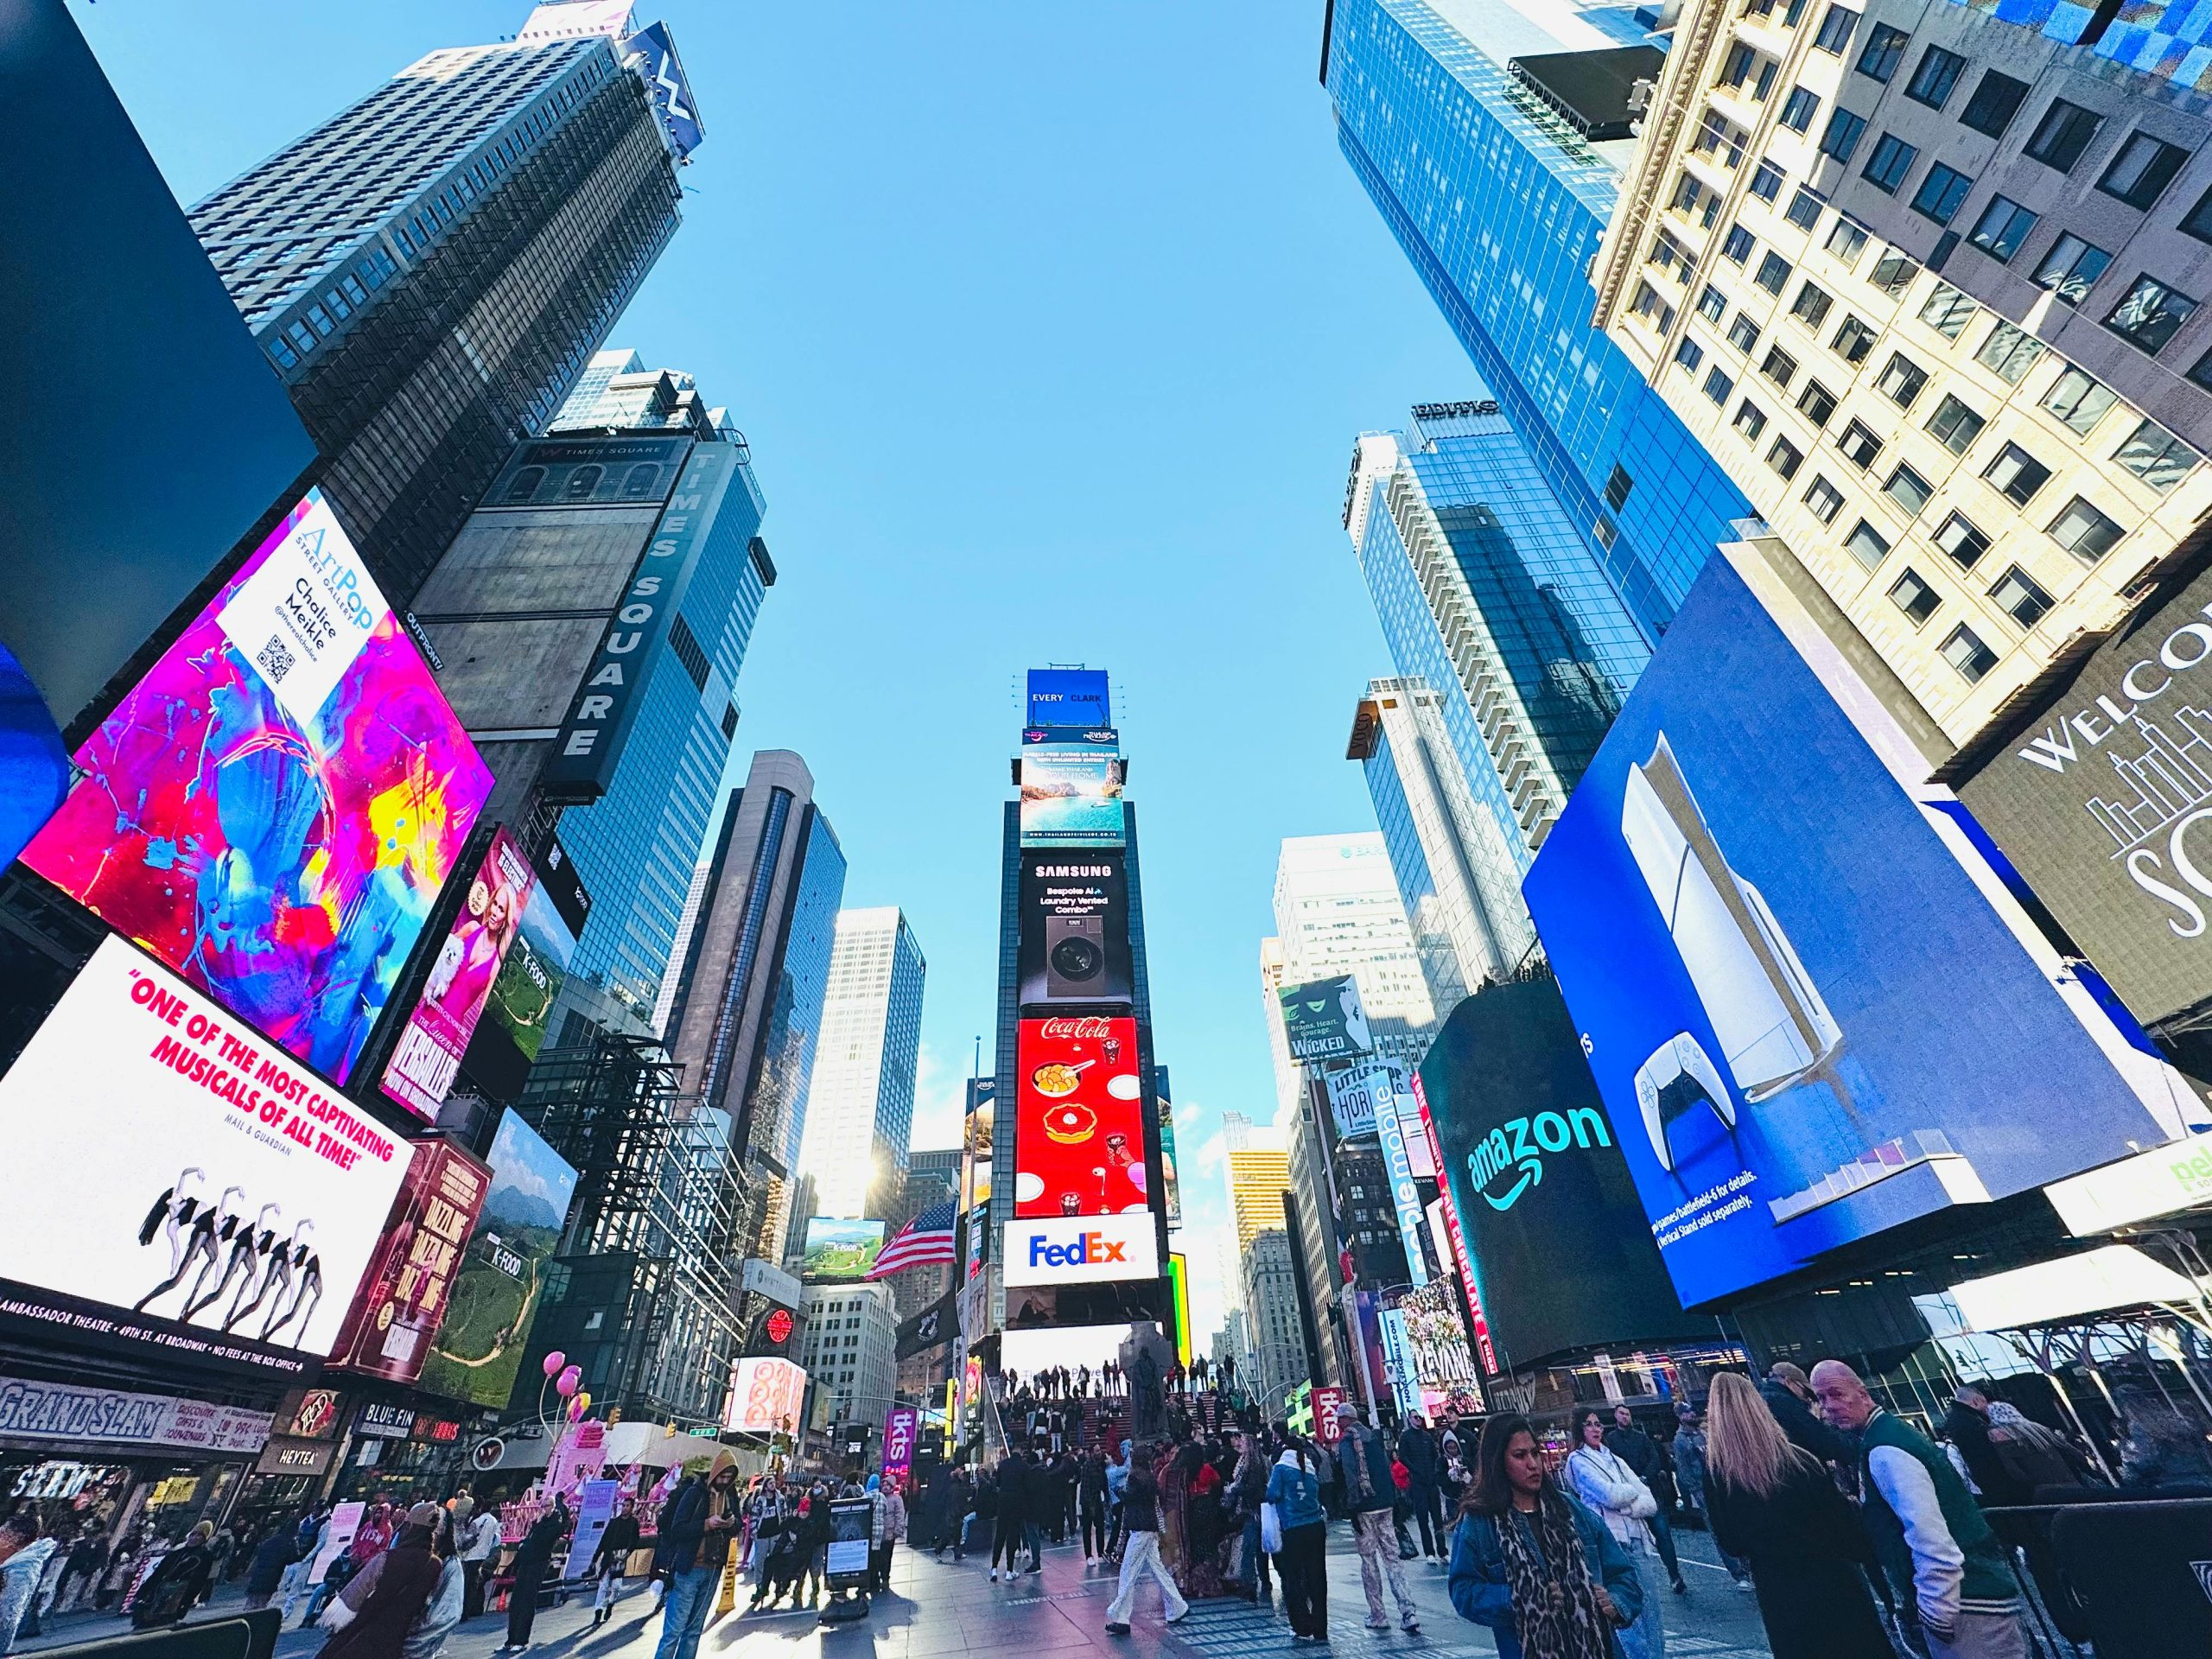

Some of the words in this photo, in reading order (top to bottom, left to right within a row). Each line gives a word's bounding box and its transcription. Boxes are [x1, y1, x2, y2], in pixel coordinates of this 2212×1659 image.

[649, 454, 715, 558] TIMES
[295, 537, 323, 575] STREET
[323, 578, 354, 621] GALLERY
[302, 528, 372, 630] ArtPop
[285, 593, 325, 650] Meikle
[296, 577, 336, 639] Chalice
[275, 606, 318, 663] @therealchalice
[563, 576, 661, 756] SQUARE
[2018, 601, 2212, 773] WELCO
[1071, 694, 1102, 702] CLARK
[1035, 865, 1112, 877] SAMSUNG
[1046, 887, 1084, 897] Bespoke
[1039, 897, 1077, 906] Laundry
[523, 952, 547, 989] K-FOOD
[417, 1015, 430, 1029] THE
[427, 1020, 454, 1051] Queen
[1291, 1021, 1316, 1032] Brains.
[1317, 1019, 1339, 1027] Heart.
[1300, 1028, 1332, 1037] Courage.
[392, 1020, 461, 1103] VERSAILLES
[1335, 1065, 1370, 1093] LITTLE
[149, 1035, 260, 1113] MUSICALS
[259, 1100, 288, 1128] OF
[283, 1116, 315, 1148] ALL
[186, 1014, 221, 1046] OF
[217, 1033, 260, 1074] THE
[254, 1060, 309, 1106] MOST
[307, 1094, 394, 1162] CAPTIVATING
[385, 1067, 404, 1094] NOW
[399, 1079, 414, 1101] ON
[407, 1086, 442, 1121] BROADWAY
[224, 1114, 245, 1130] MAIL
[245, 1125, 252, 1135] &
[254, 1129, 292, 1156] GUARDIAN
[1467, 1104, 1612, 1193] amazon
[1716, 1184, 1729, 1198] for
[1728, 1170, 1758, 1192] details.
[1678, 1218, 1699, 1237] Stand
[1697, 1211, 1714, 1229] sold
[1713, 1194, 1753, 1222] separately.
[491, 1247, 522, 1277] K-FOOD
[833, 1243, 858, 1252] K-FOOD
[1029, 1232, 1128, 1268] FedEx
[1452, 1226, 1484, 1327] CHOCOLATE
[0, 1300, 70, 1324] AMBASSADOR
[75, 1315, 112, 1333] THEATRE
[118, 1325, 141, 1338] 49TH
[142, 1329, 152, 1343] ST.
[154, 1333, 166, 1344] AT
[166, 1335, 208, 1352] BROADWAY
[214, 1345, 226, 1357] NO
[226, 1348, 242, 1360] FEES
[242, 1351, 251, 1362] AT
[251, 1353, 262, 1363] THE
[263, 1356, 276, 1366] BOX
[275, 1358, 296, 1371] OFFICE
[1414, 1341, 1471, 1384] KEVANI
[365, 1404, 395, 1425] BLUE
[395, 1409, 416, 1427] FIN
[890, 1412, 912, 1460] tkts
[1319, 1390, 1340, 1440] tkts
[278, 1449, 316, 1465] HEYTEA
